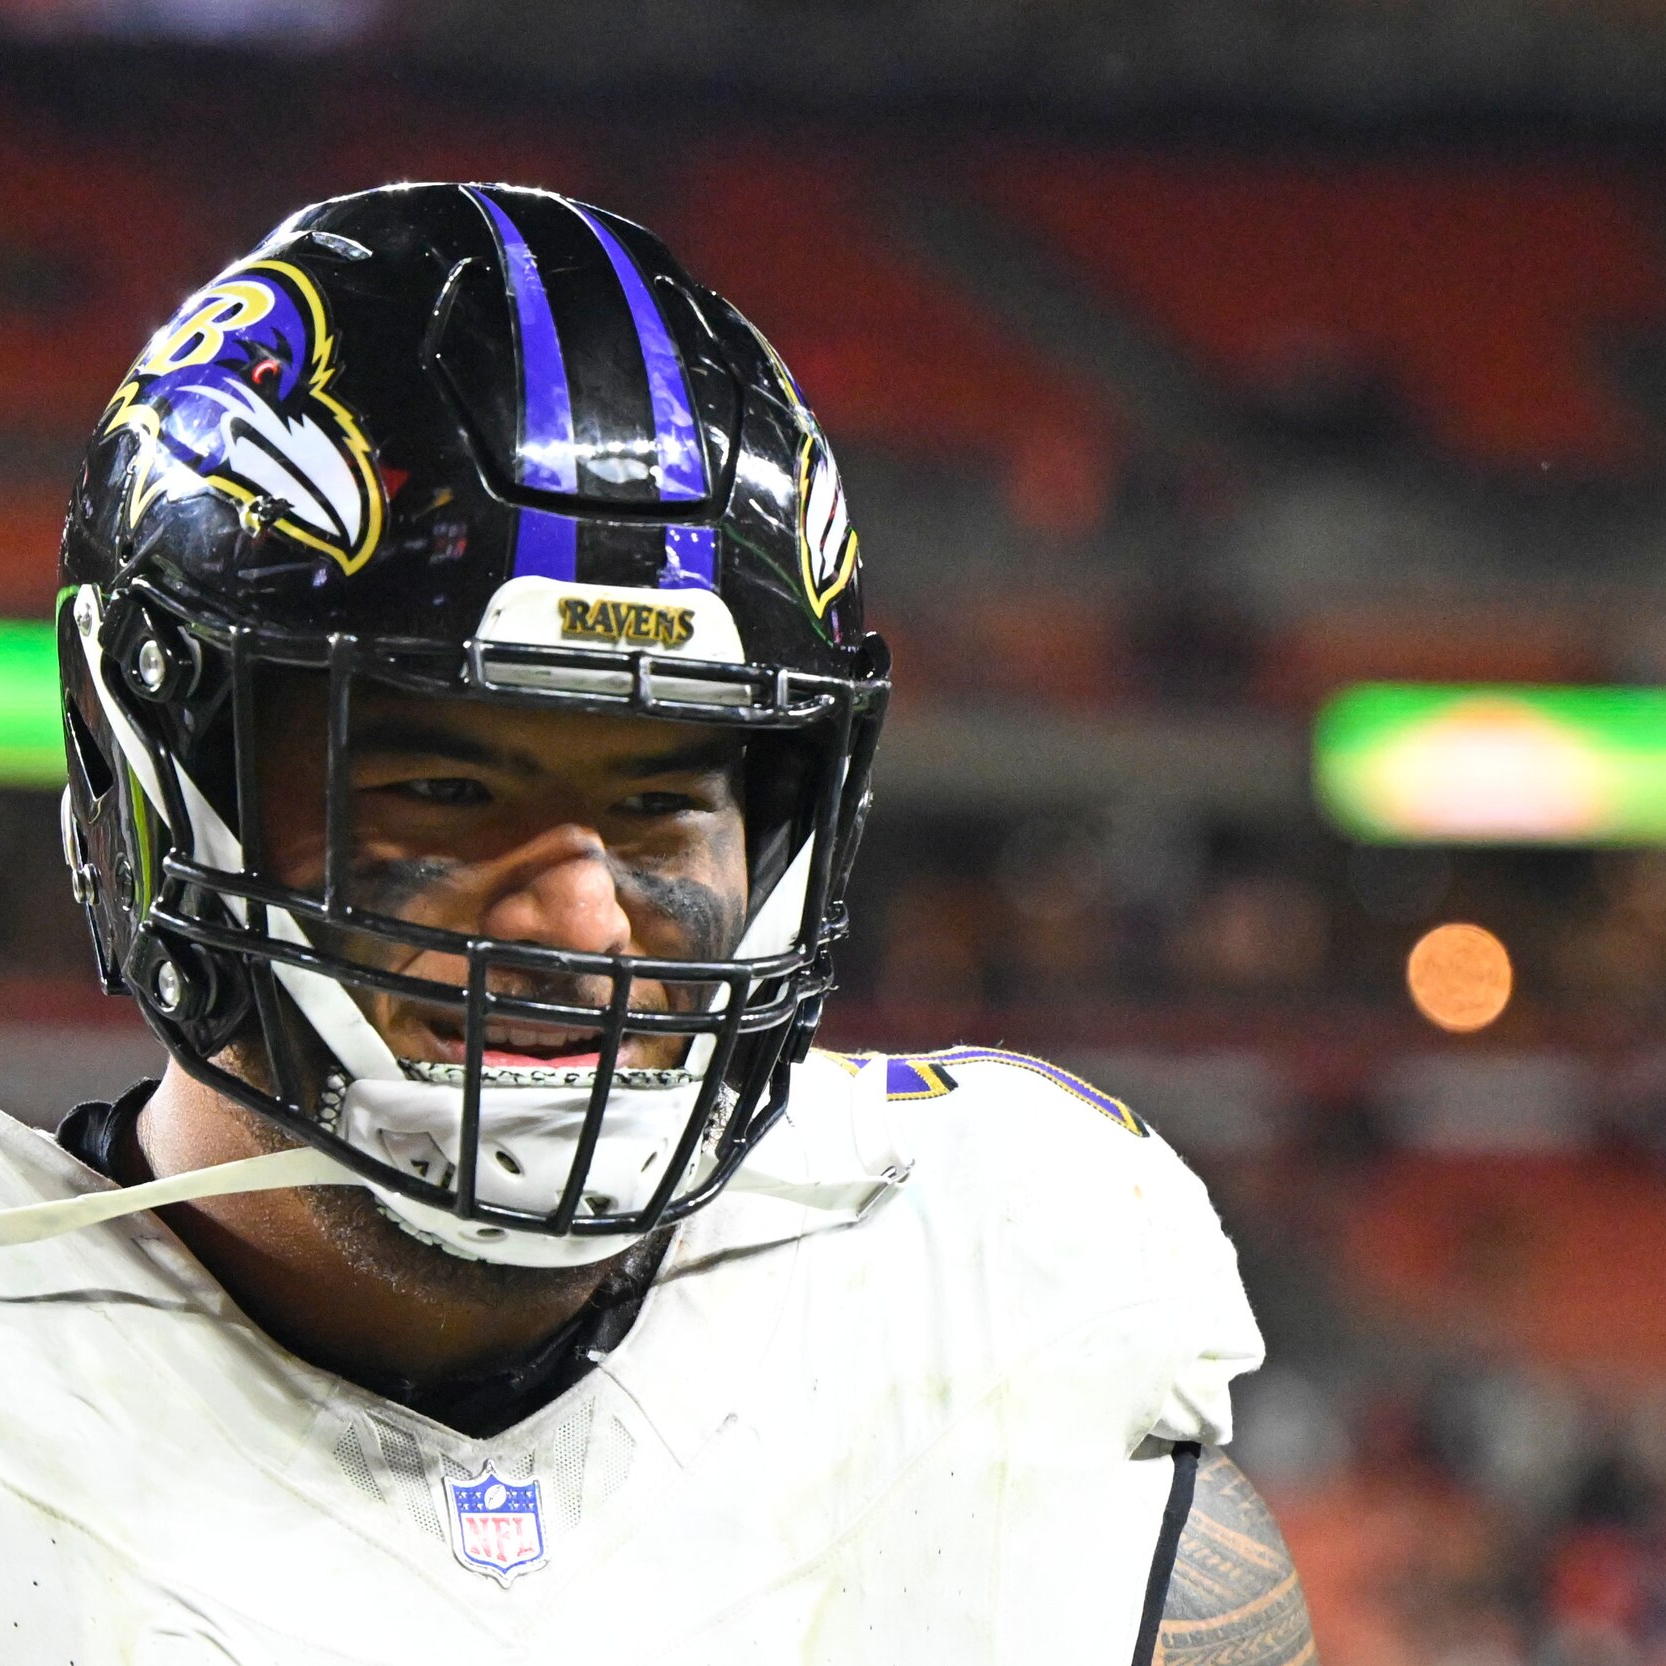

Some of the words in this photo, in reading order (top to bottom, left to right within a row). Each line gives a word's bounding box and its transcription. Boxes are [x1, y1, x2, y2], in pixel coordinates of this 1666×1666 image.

[136, 280, 276, 378] B
[558, 597, 695, 648] RAVENS
[465, 1517, 536, 1563] NFL
